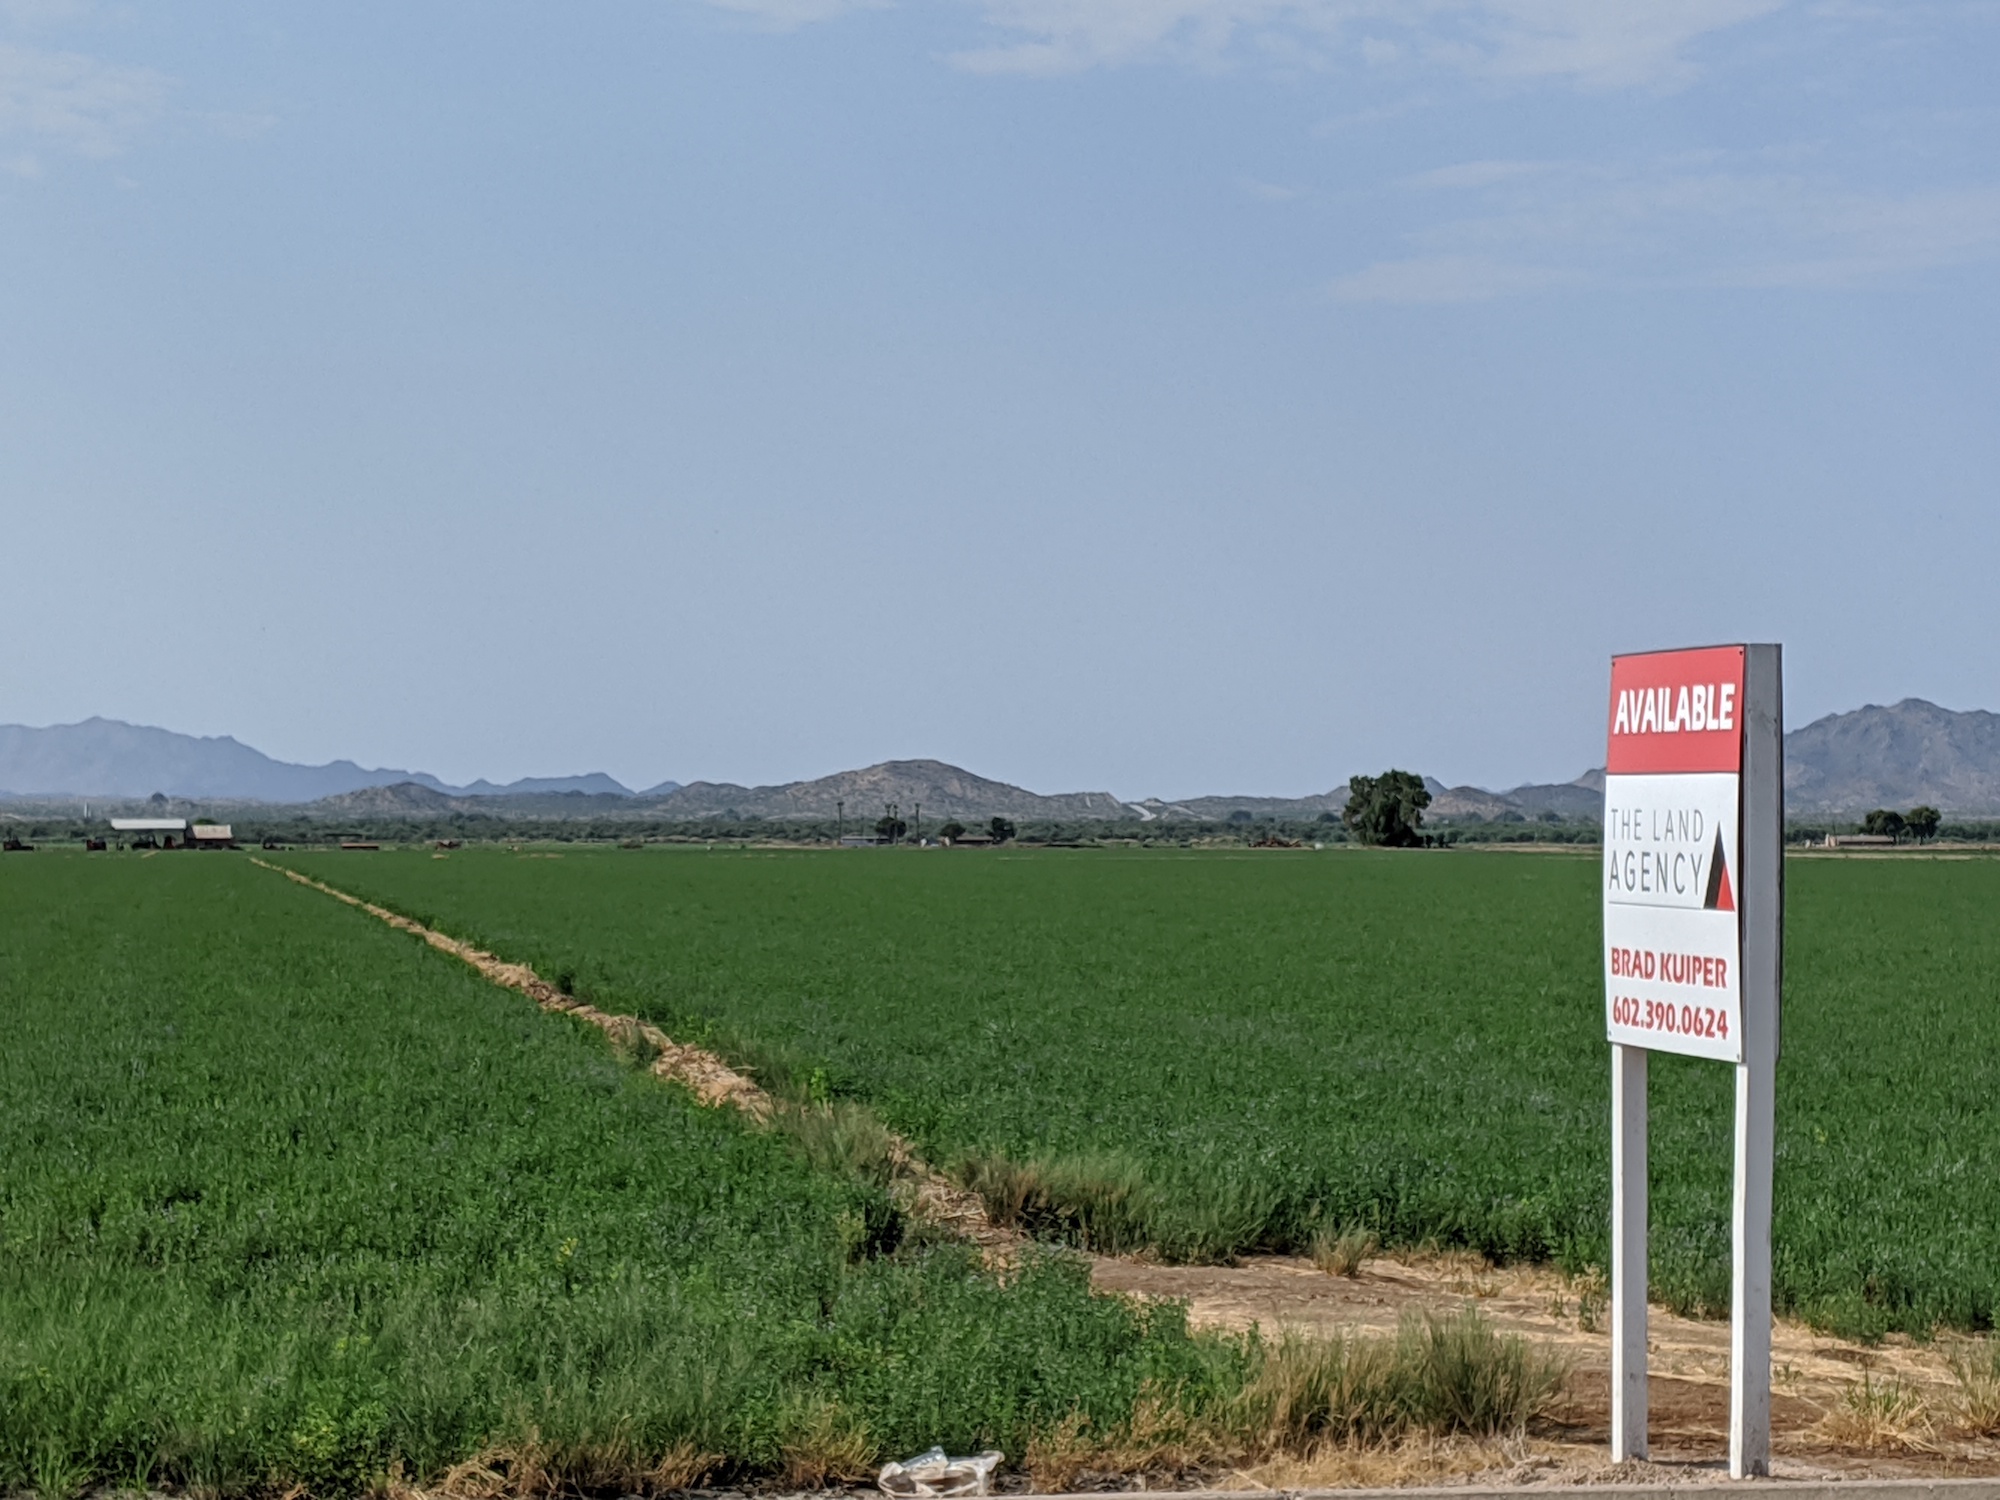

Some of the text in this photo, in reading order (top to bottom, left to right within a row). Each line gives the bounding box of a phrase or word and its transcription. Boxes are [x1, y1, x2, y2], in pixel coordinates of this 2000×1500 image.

[1613, 683, 1736, 735] AVAILABLE
[1611, 808, 1704, 843] THE LAND
[1608, 850, 1703, 896] AGENCY
[1611, 947, 1727, 989] BRAD KUIPER
[1612, 995, 1729, 1040] 602.390.0624
